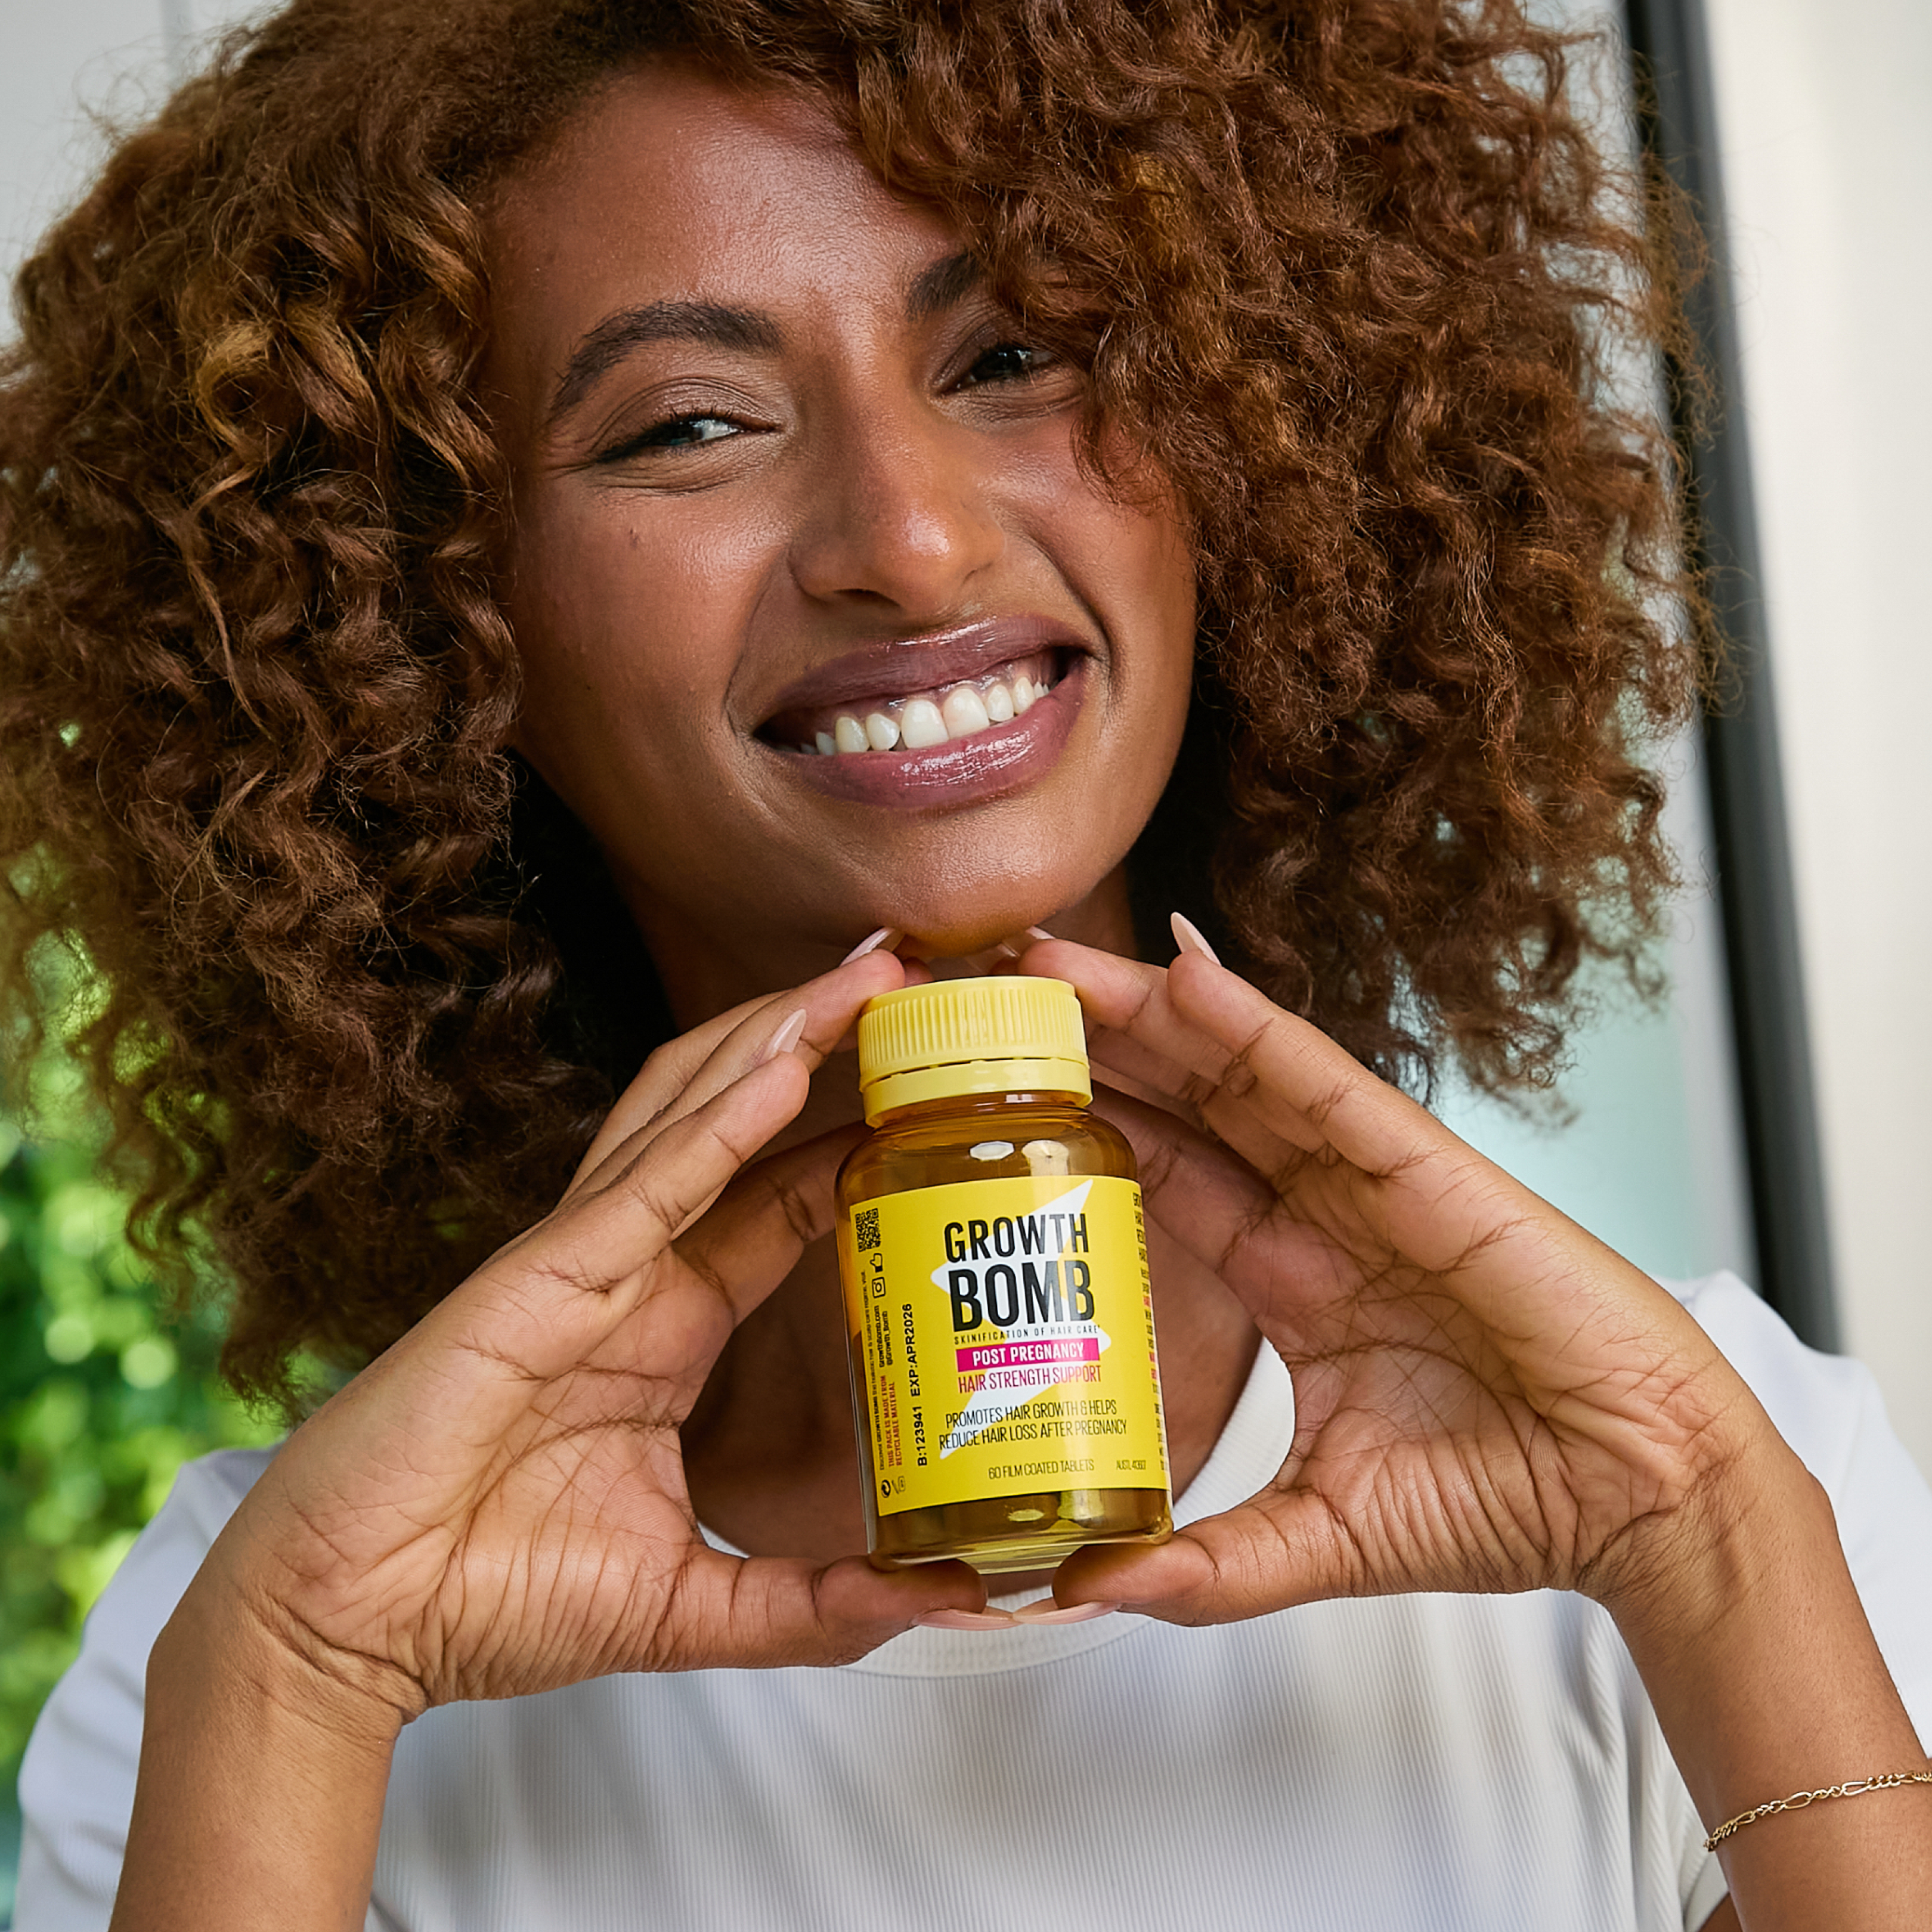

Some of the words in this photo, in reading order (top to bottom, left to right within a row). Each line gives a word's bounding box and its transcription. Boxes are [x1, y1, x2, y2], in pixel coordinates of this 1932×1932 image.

[944, 1213, 1089, 1263] GROWTH
[948, 1260, 1095, 1332] BOMB
[902, 1304, 921, 1397] EXP:APR2026
[954, 1329, 1029, 1345] SKINIFICATION
[1034, 1327, 1045, 1336] OF
[1051, 1326, 1072, 1335] HAIR
[973, 1348, 1006, 1367] POST
[1010, 1342, 1084, 1362] PREGNANCY
[958, 1373, 987, 1394] HAIR
[989, 1367, 1051, 1390] STRENGTH
[1053, 1366, 1101, 1384] SUPPORT
[888, 1382, 898, 1418] MATERIAL
[946, 1407, 1003, 1429] PROMOTES
[1006, 1404, 1031, 1422] HAIR
[1033, 1401, 1078, 1419] GROWTH
[1080, 1401, 1088, 1416] &
[1089, 1400, 1117, 1415] HELPS
[892, 1419, 902, 1466] RECYCLABLE
[912, 1406, 927, 1466] B:123941
[939, 1430, 980, 1450] REDUCE
[982, 1427, 1008, 1444] HAIR
[1010, 1423, 1038, 1441] LOSS
[1040, 1421, 1073, 1439] AFTER
[1075, 1419, 1127, 1435] PREGNANCY
[989, 1466, 1002, 1479] 60
[1003, 1464, 1023, 1478] FILM
[1024, 1461, 1058, 1475] COATED
[1060, 1459, 1095, 1472] TABLETS
